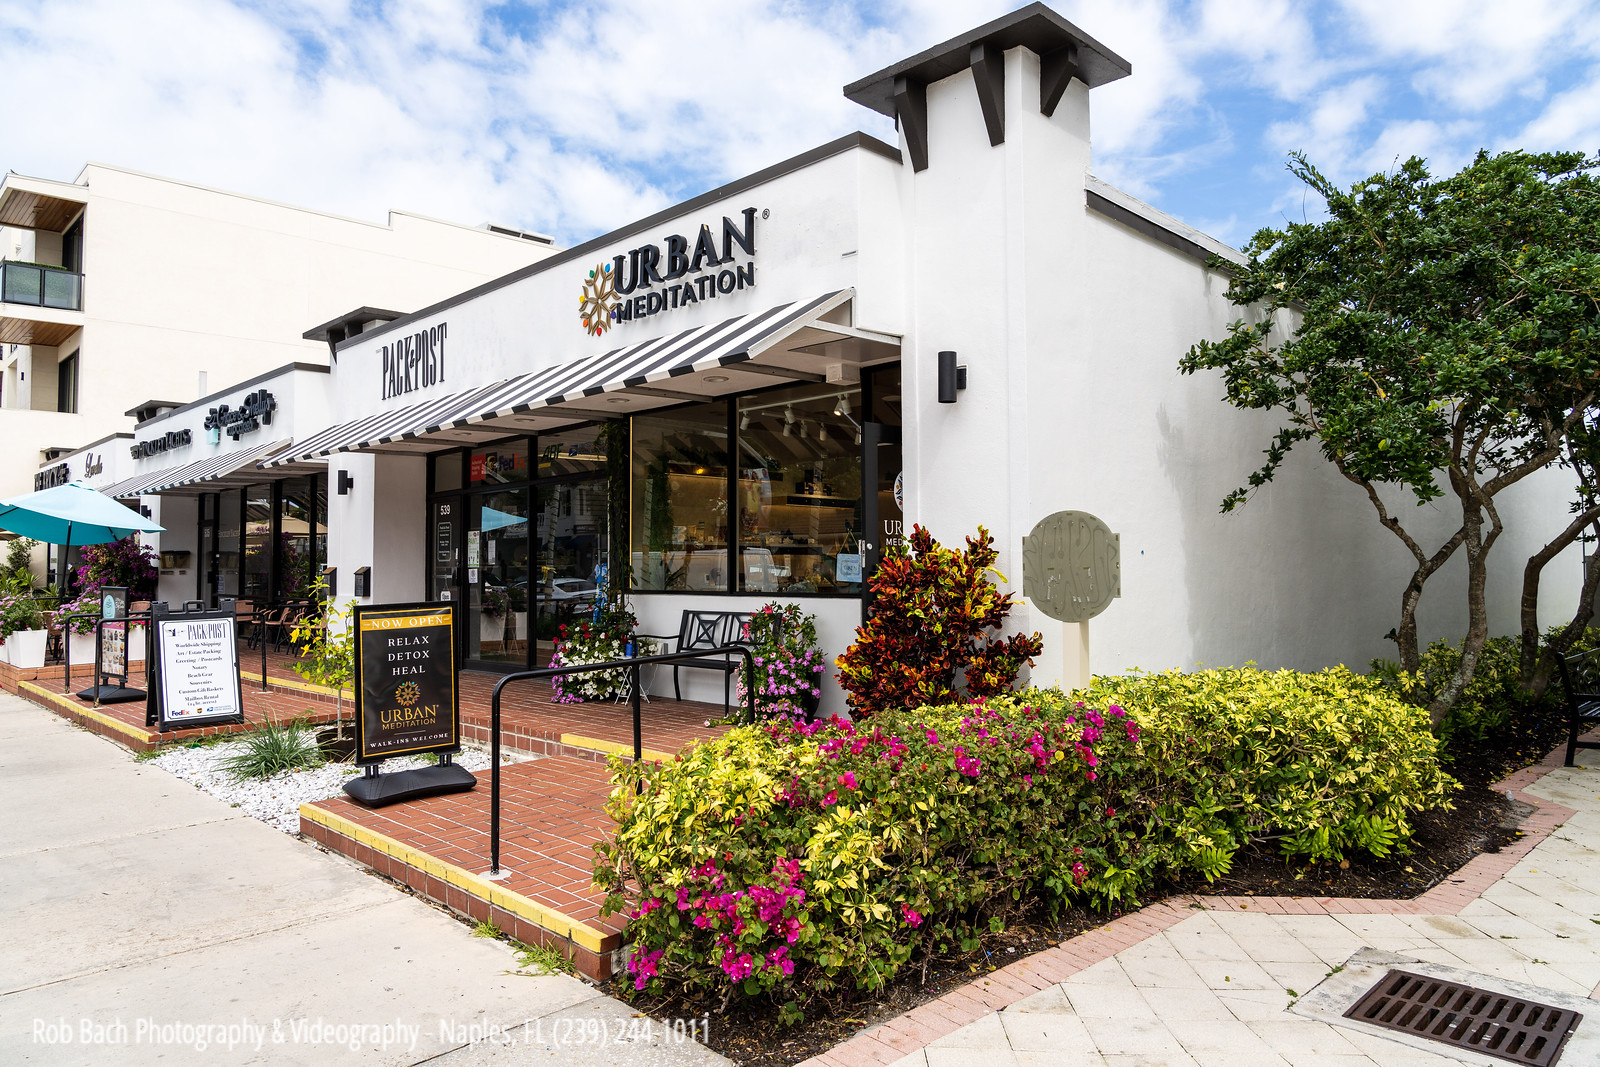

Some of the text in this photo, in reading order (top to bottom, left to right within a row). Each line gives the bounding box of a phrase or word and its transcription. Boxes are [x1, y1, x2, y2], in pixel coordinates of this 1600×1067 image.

[613, 207, 757, 295] URBAN
[616, 262, 755, 324] MEDITATION
[498, 452, 526, 471] FedEx
[440, 505, 450, 515] 539
[371, 616, 443, 629] NOW OPEN
[388, 635, 430, 647] RELAX
[388, 650, 430, 661] DETOX
[392, 665, 426, 676] HEAL
[380, 704, 437, 723] URBAN
[382, 717, 436, 730] MEDITATION
[370, 732, 449, 748] WALK-INS WELCOME
